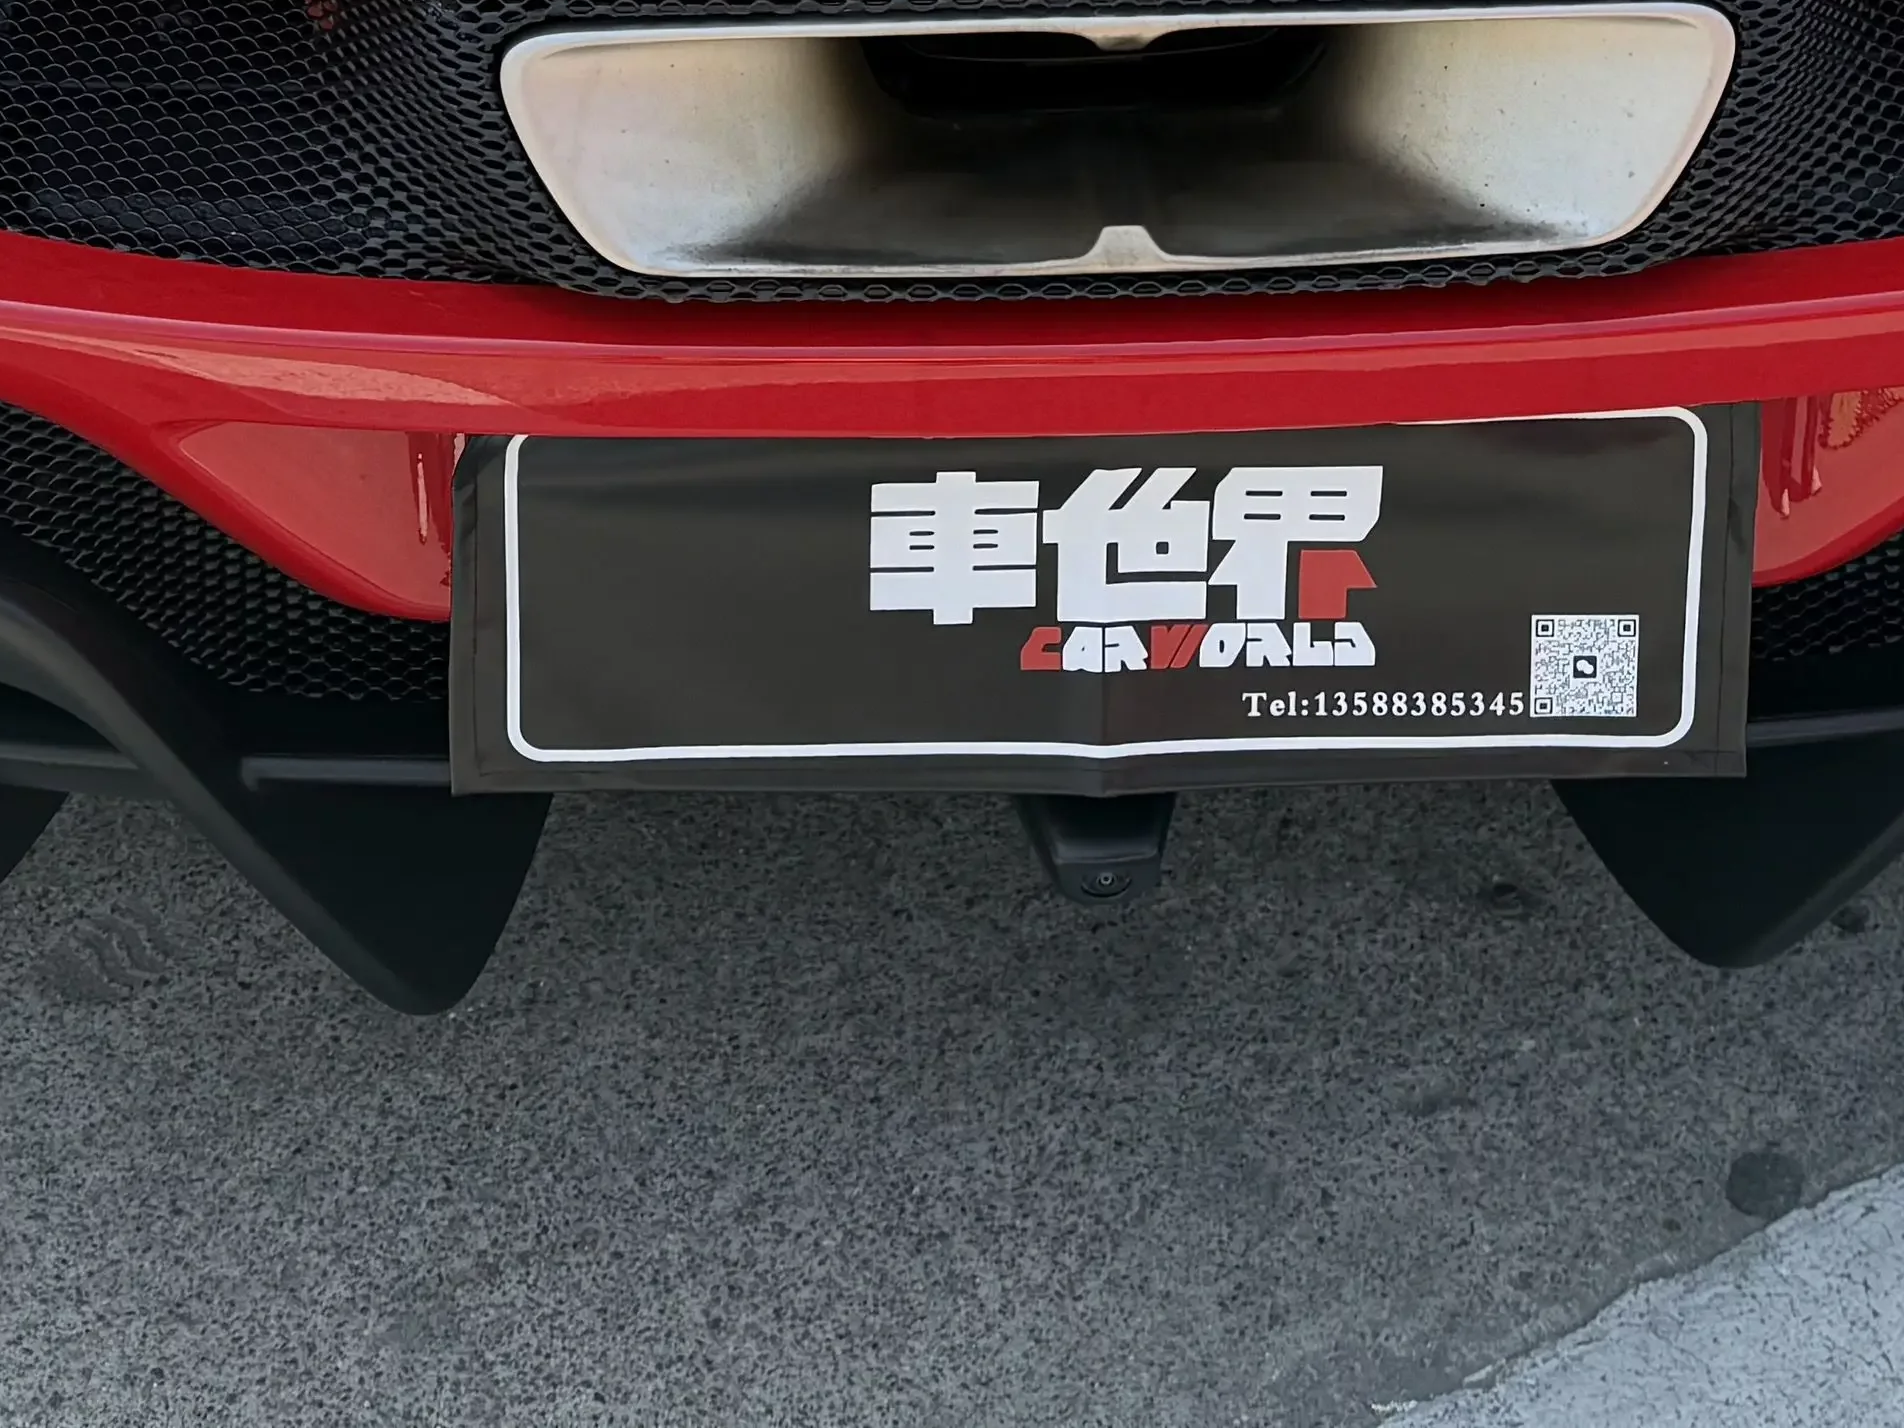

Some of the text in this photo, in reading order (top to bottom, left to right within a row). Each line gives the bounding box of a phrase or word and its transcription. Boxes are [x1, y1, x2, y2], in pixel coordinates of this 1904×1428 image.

[869, 465, 1384, 625] 車世界
[1242, 691, 1525, 718] Tel:13588385345
